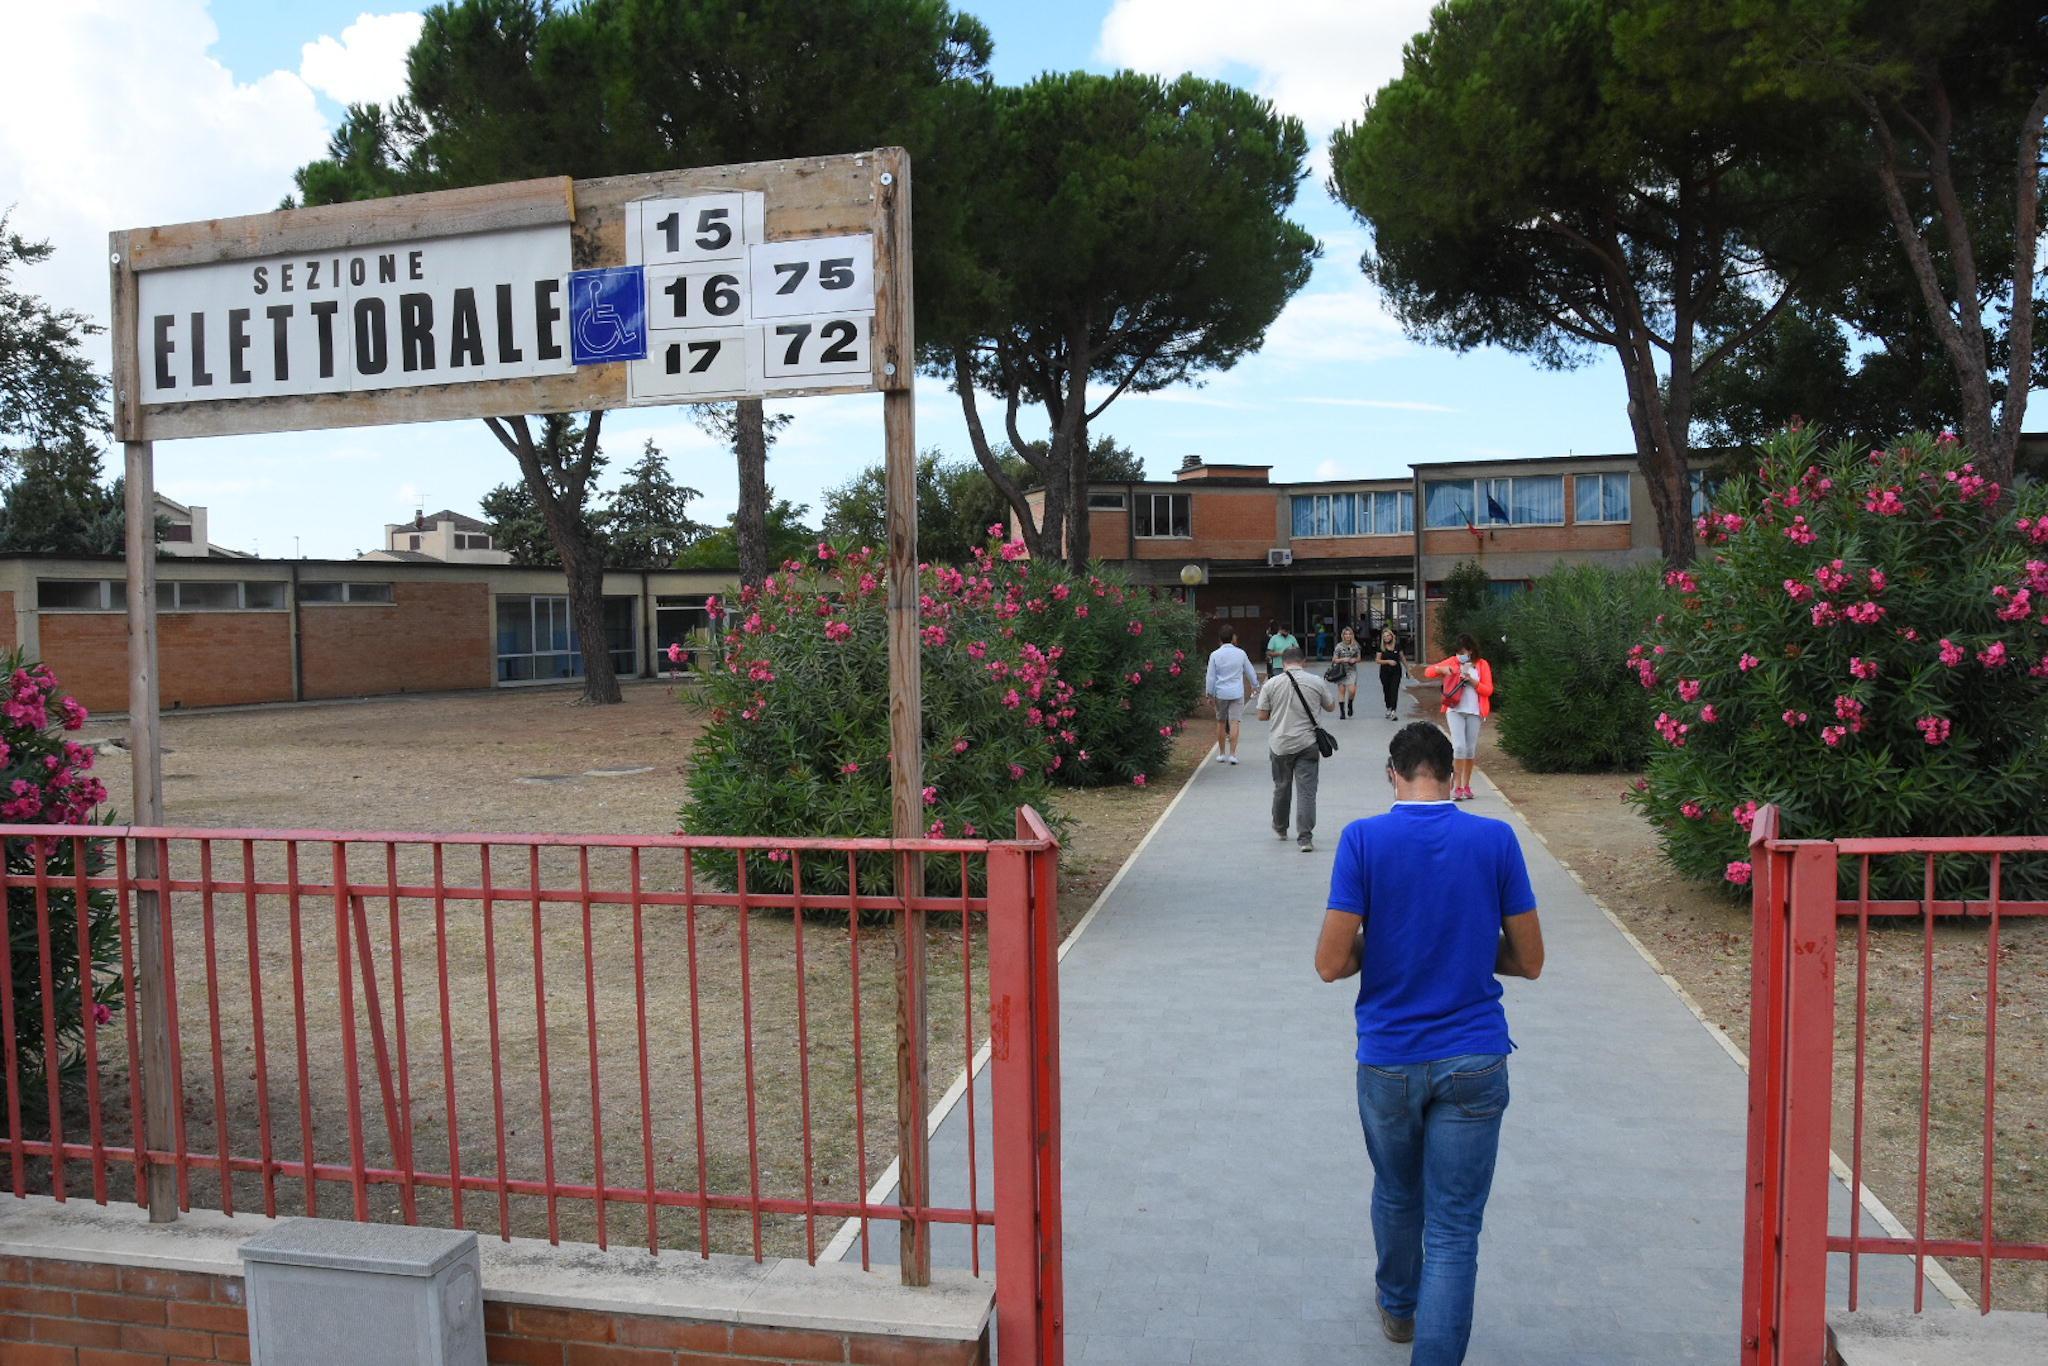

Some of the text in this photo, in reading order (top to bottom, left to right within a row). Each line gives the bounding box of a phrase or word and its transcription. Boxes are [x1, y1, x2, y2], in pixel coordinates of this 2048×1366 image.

[656, 208, 733, 253] 15
[253, 250, 424, 295] SEZIONE
[773, 257, 856, 296] 75
[664, 273, 741, 318] 16
[154, 279, 561, 390] ELETTORALE
[775, 319, 858, 365] 72
[665, 340, 722, 375] 17
